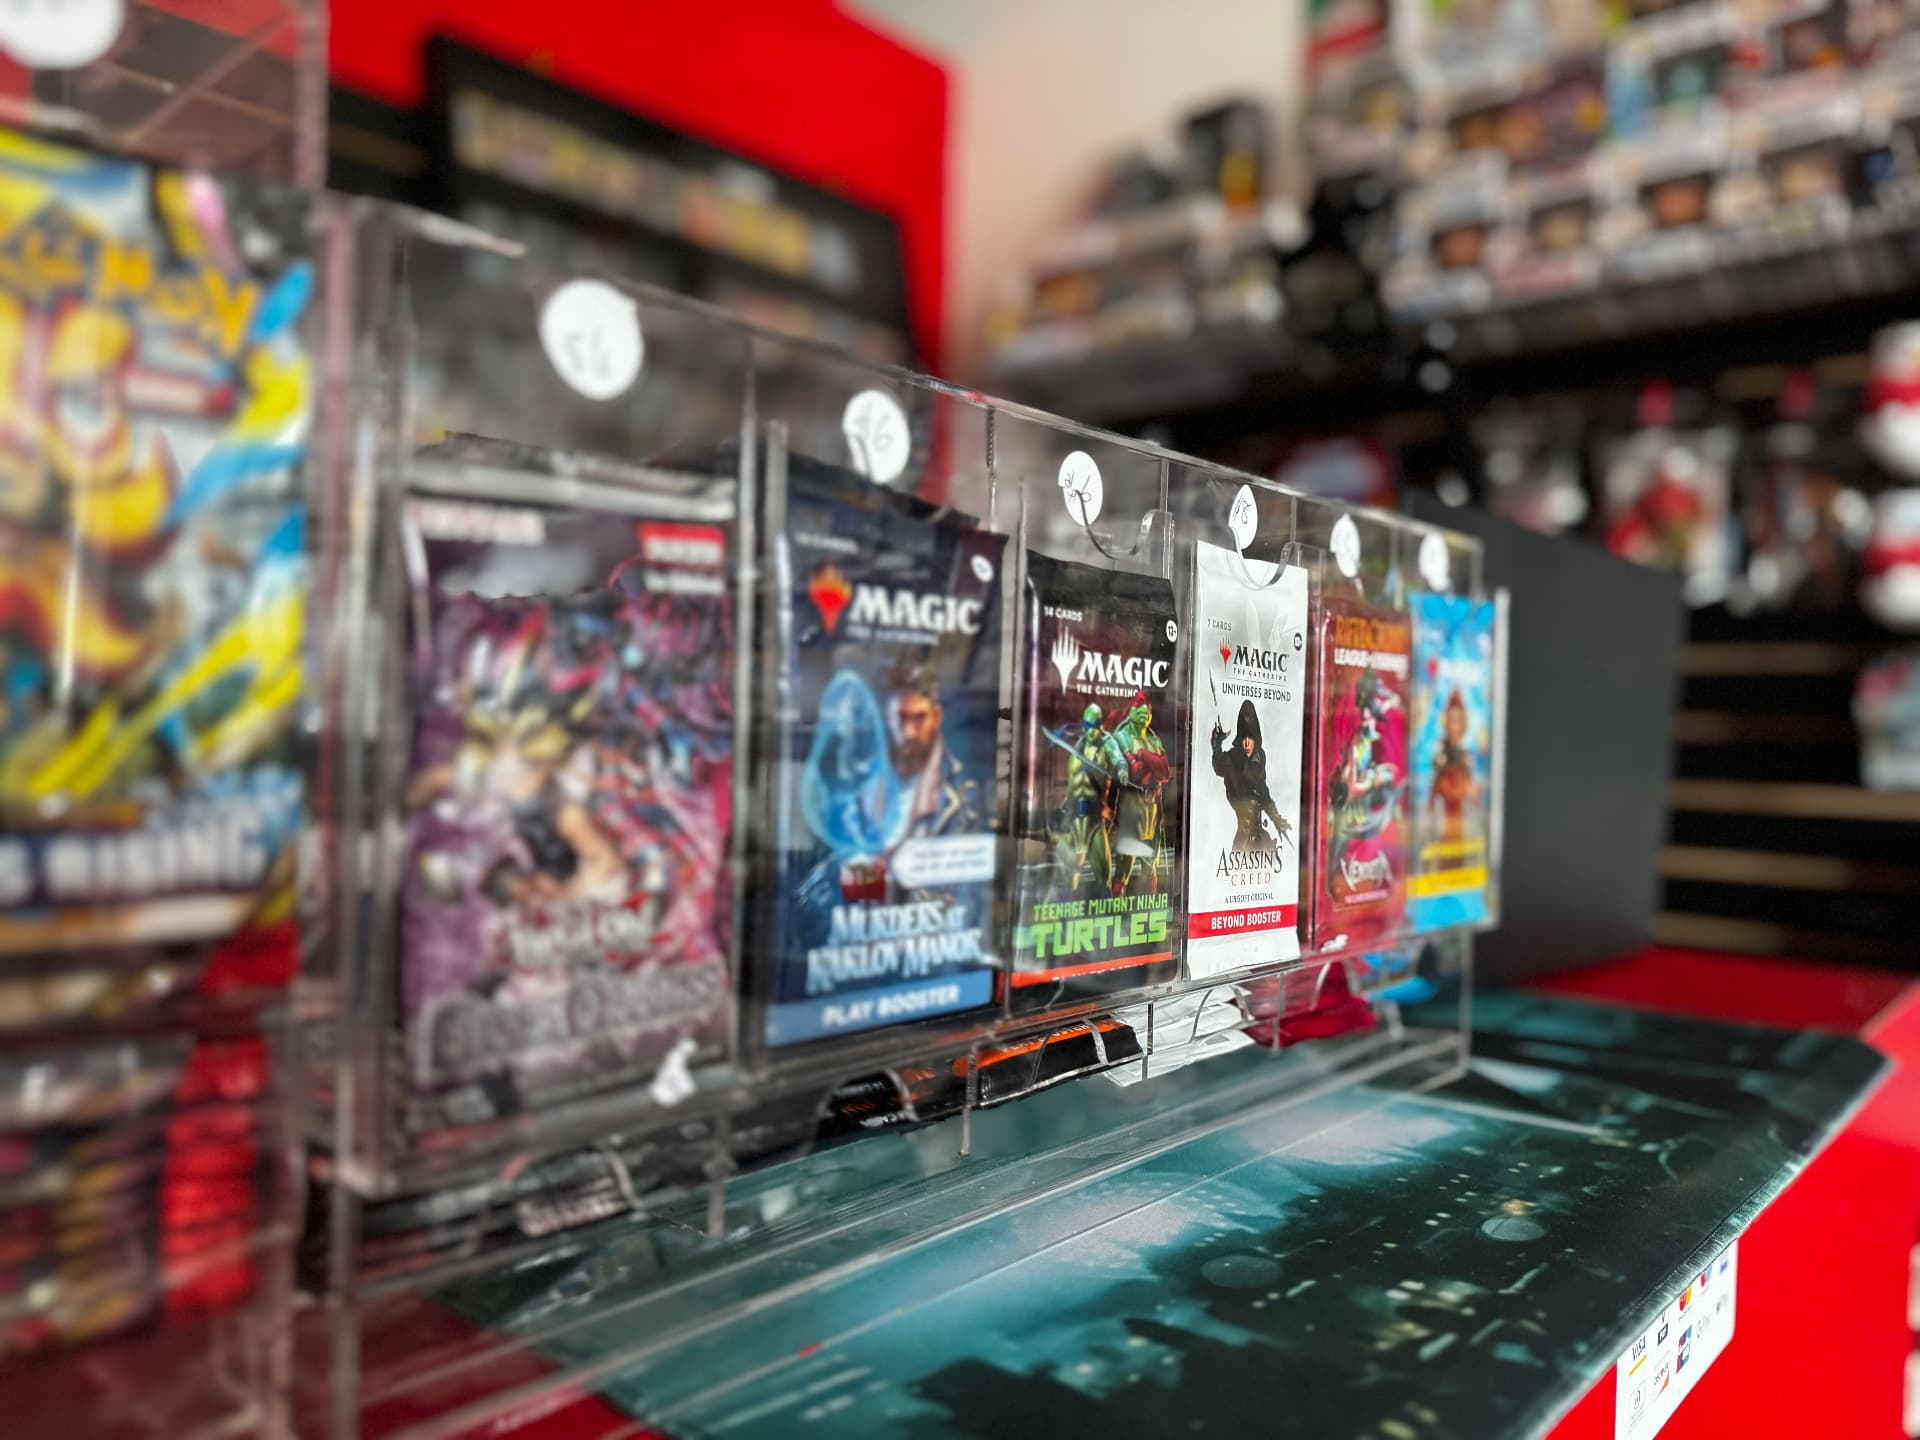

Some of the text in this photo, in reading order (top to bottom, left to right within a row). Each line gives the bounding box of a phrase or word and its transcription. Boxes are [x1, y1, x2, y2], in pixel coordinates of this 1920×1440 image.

[850, 583, 984, 636] MAGIC
[1044, 605, 1083, 622] 14 CARDS
[1212, 620, 1232, 632] CARDS
[1076, 650, 1169, 691] MAGIC
[1233, 645, 1288, 673] MAGIC
[1233, 667, 1287, 682] THE GATHERING
[1076, 683, 1092, 694] THE
[1222, 682, 1292, 702] UNIVERSES BEYOND
[1231, 872, 1271, 887] CREED
[1033, 892, 1169, 922] TEENAGE MUTANT NINJA
[1229, 894, 1250, 904] UBISOFT
[1250, 892, 1274, 902] ORIGINAL
[827, 900, 945, 946] MURDERS
[1211, 910, 1281, 930] BEYOND BOOSTER
[1030, 911, 1168, 959] TURTLES
[805, 929, 983, 994] KARLOV MANOR
[821, 984, 961, 1027] PLAY BOOSTER
[1632, 1335, 1646, 1361] VISA
